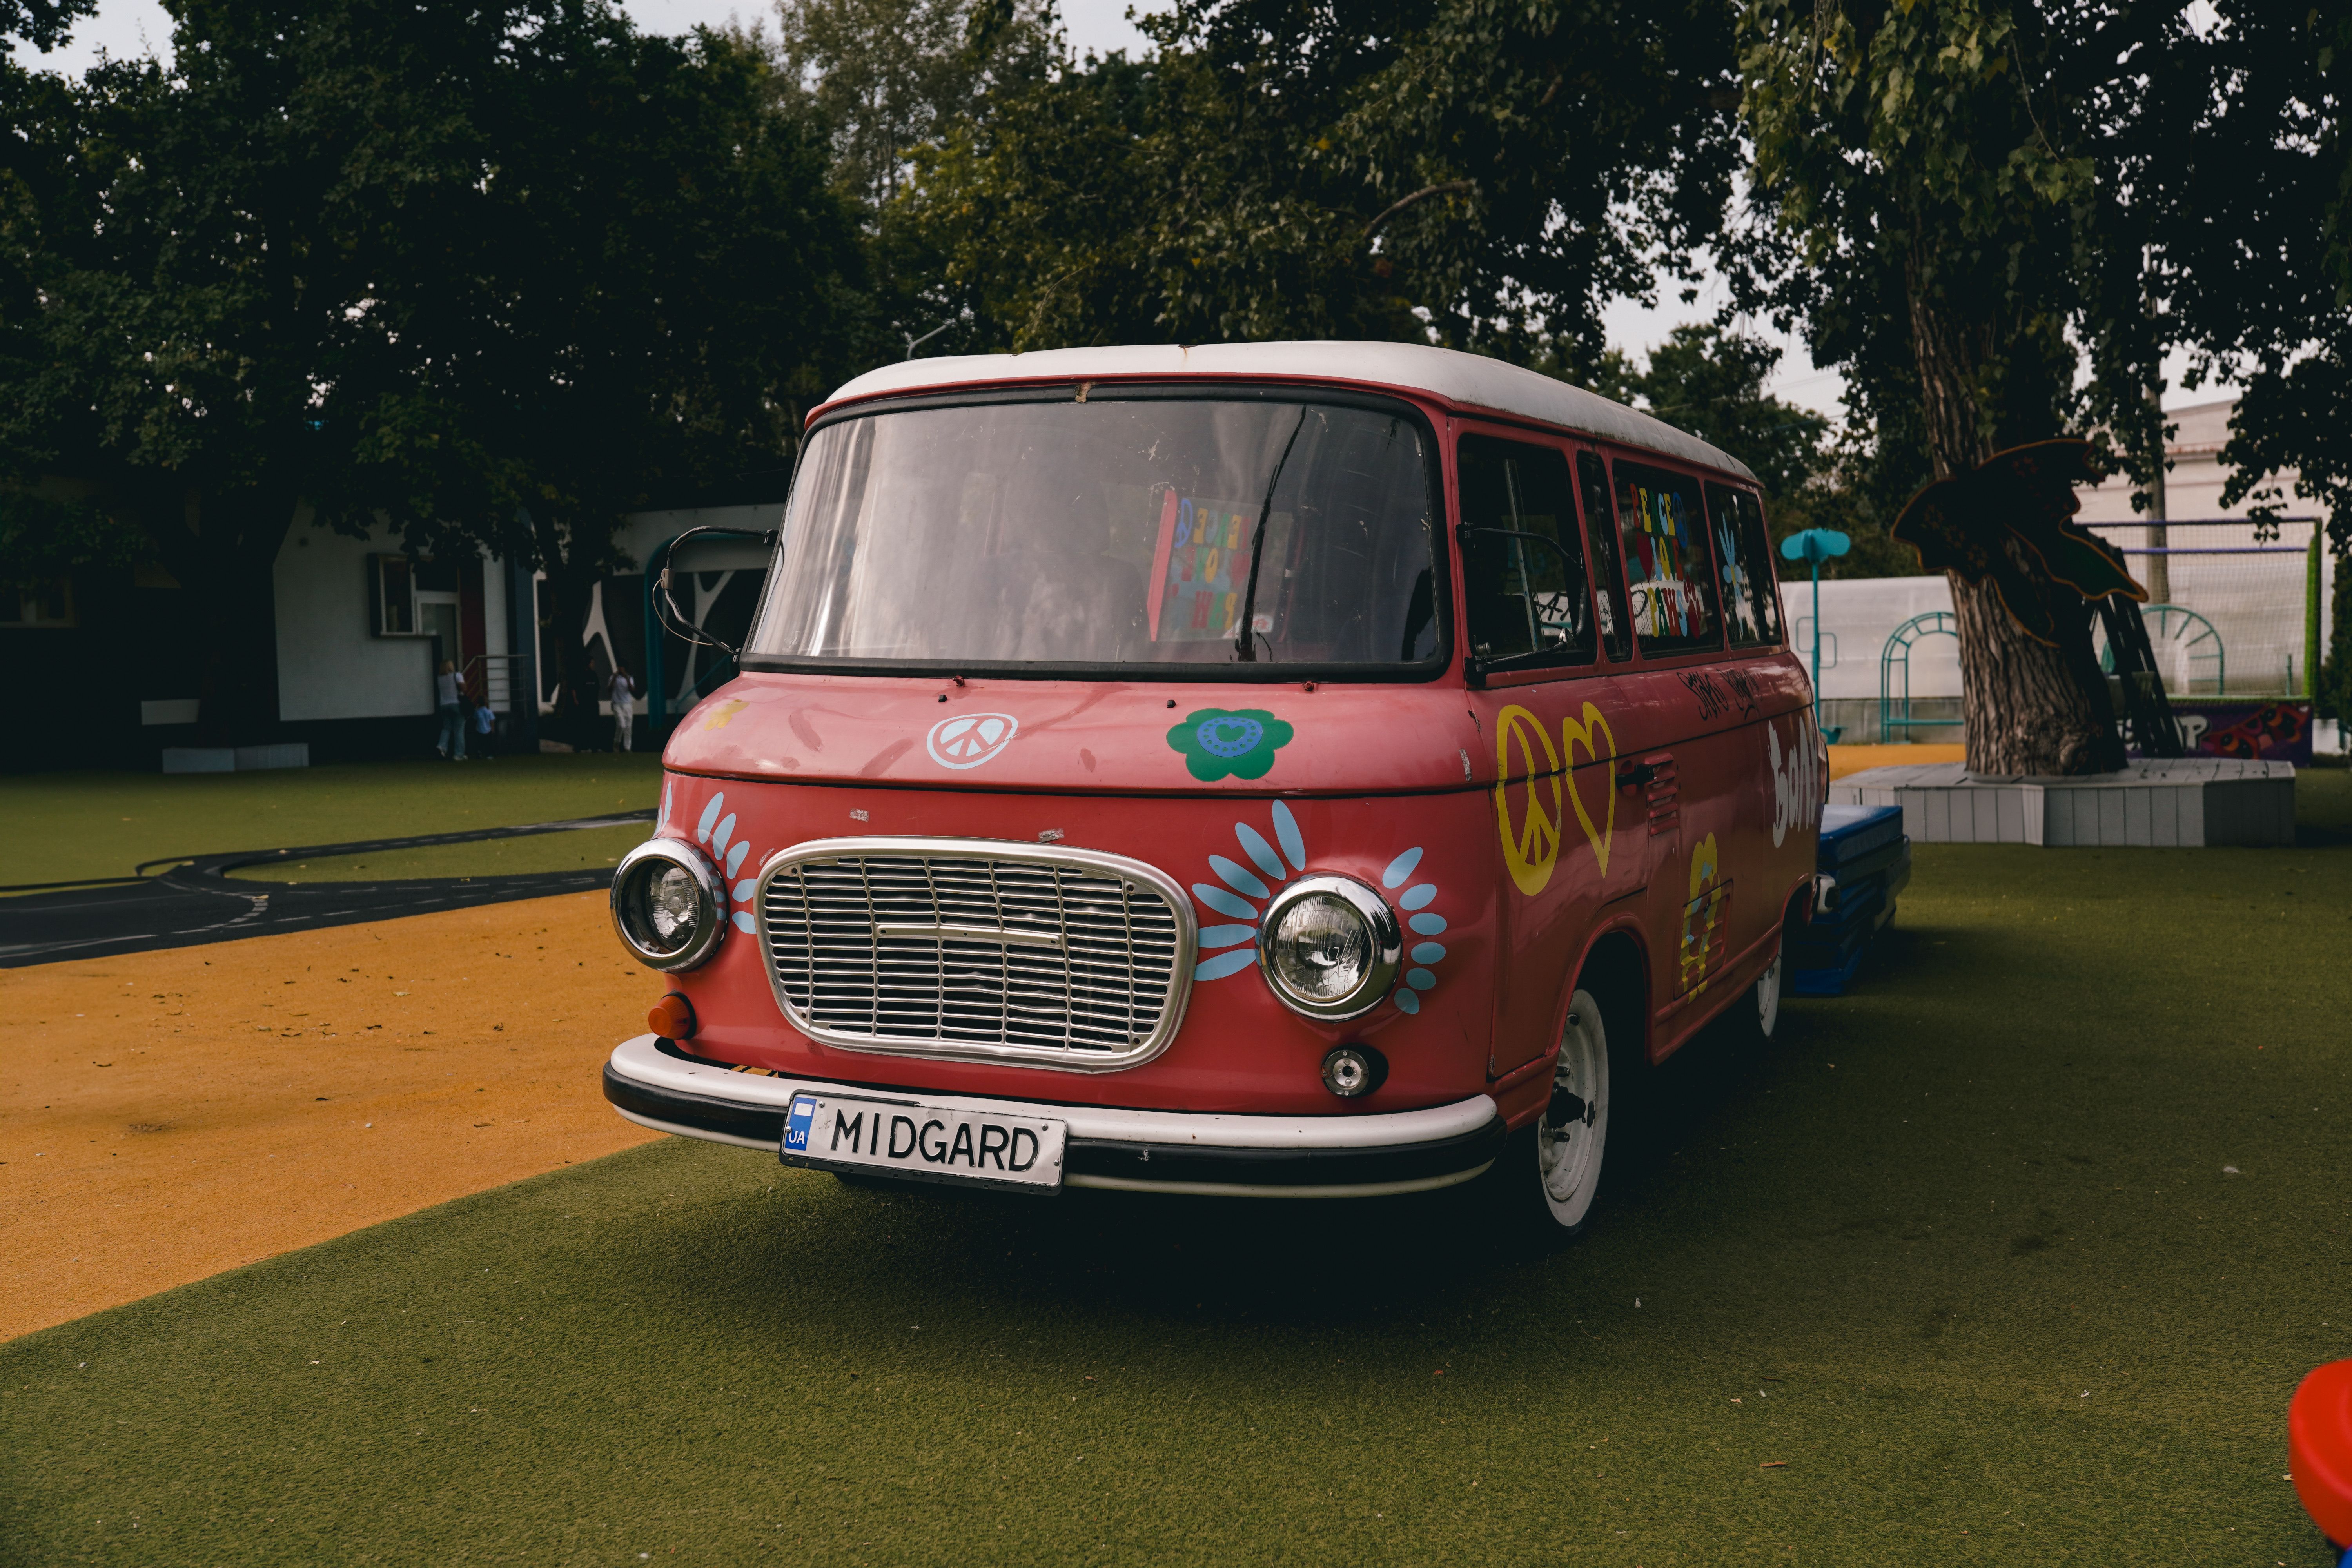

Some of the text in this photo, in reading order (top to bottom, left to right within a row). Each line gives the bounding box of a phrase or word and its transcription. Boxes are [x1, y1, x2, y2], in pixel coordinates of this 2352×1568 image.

[1630, 483, 1676, 536] PEACE
[1650, 536, 1684, 581] LOVE
[1647, 587, 1688, 638] PAWS
[788, 1130, 805, 1145] UA
[830, 1107, 1040, 1172] MIDGARD
